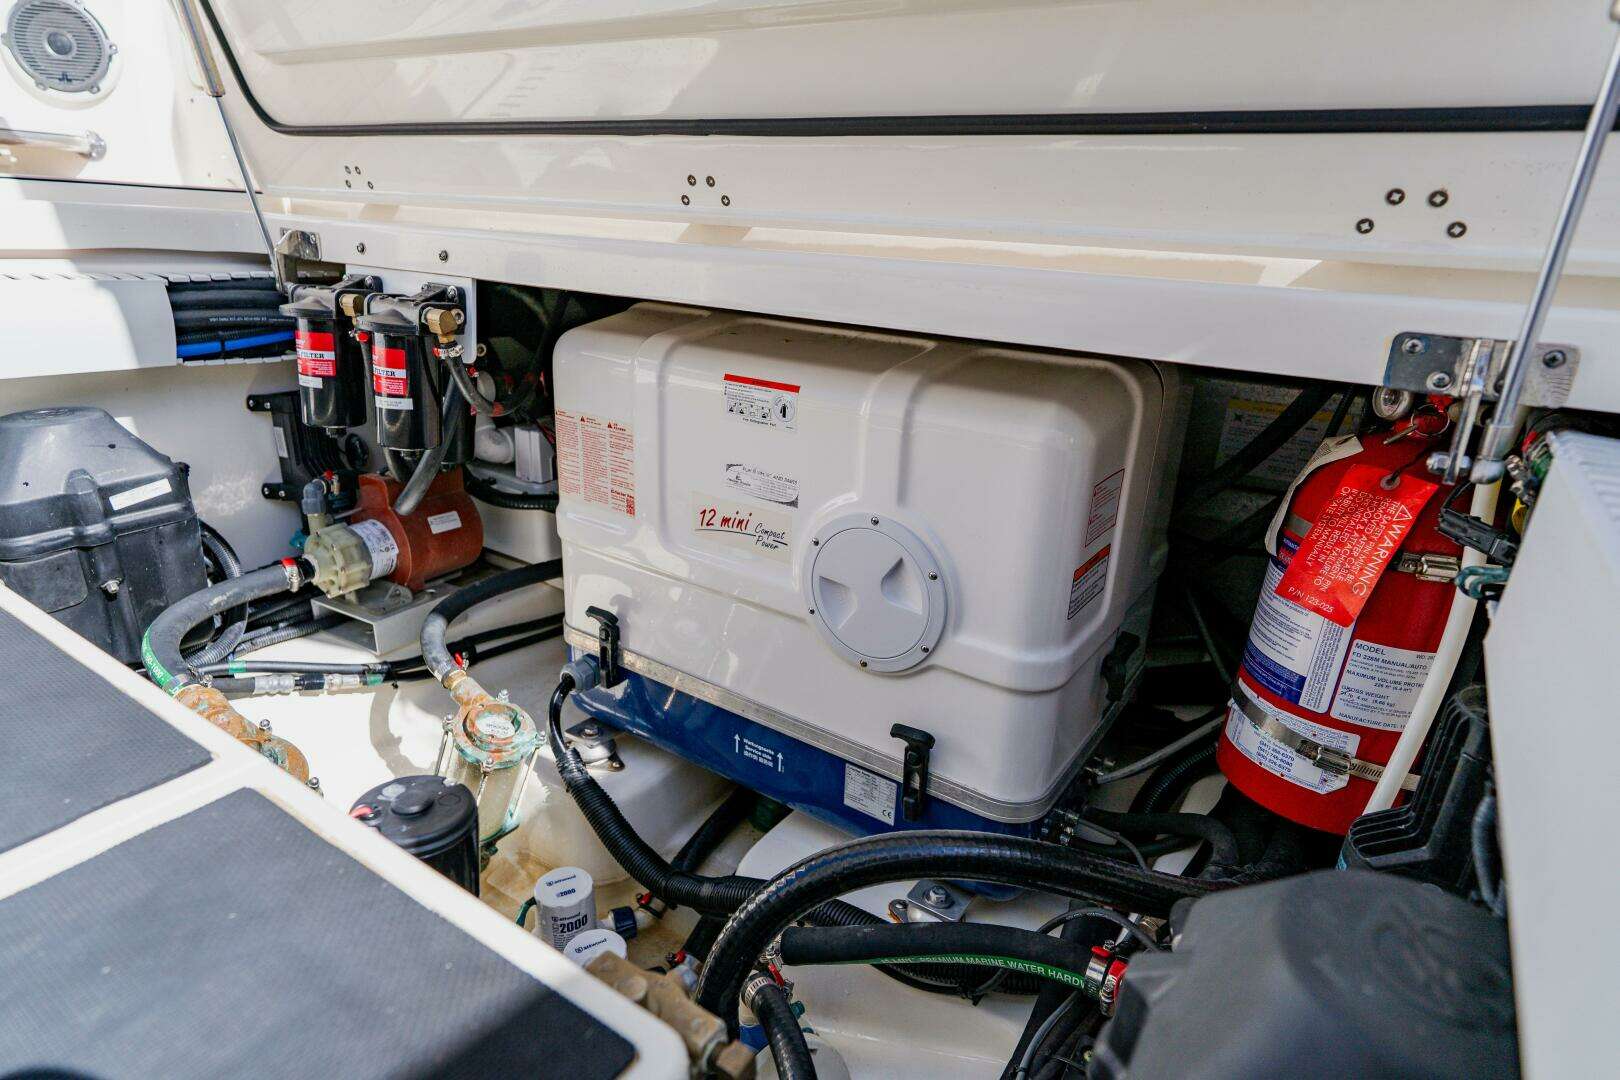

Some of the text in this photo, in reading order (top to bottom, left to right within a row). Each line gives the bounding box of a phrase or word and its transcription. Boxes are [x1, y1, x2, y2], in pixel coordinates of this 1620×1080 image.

[1347, 502, 1358, 514] SO
[700, 508, 785, 540] 12 mini Compact
[1328, 516, 1339, 527] TO
[1336, 514, 1350, 530] WILL
[756, 536, 779, 550] Power
[1305, 527, 1332, 566] MANUALLY
[1322, 529, 1341, 554] RESULT
[1336, 496, 1391, 582] REMOVED AFTER CABLE
[1344, 500, 1399, 585] THE SAFETY PIN MUST BE
[1317, 553, 1326, 563] IN
[1320, 547, 1340, 575] FAILURE
[1328, 530, 1360, 579] ATTACHMENT
[1352, 523, 1405, 596] WARNING
[1313, 574, 1324, 586] TO
[1320, 579, 1331, 592] PIN
[1288, 586, 1334, 614] P/N 123-025
[1355, 642, 1387, 655] MODEL
[1346, 670, 1376, 681] MAXIMUM
[1378, 677, 1402, 686] VOLUME
[1342, 685, 1390, 700] GROSS WEIGHT
[1338, 712, 1381, 726] MANUFACTURE
[560, 913, 588, 934] 2000
[966, 957, 1004, 967] MARINE
[1006, 960, 1045, 975] WATER
